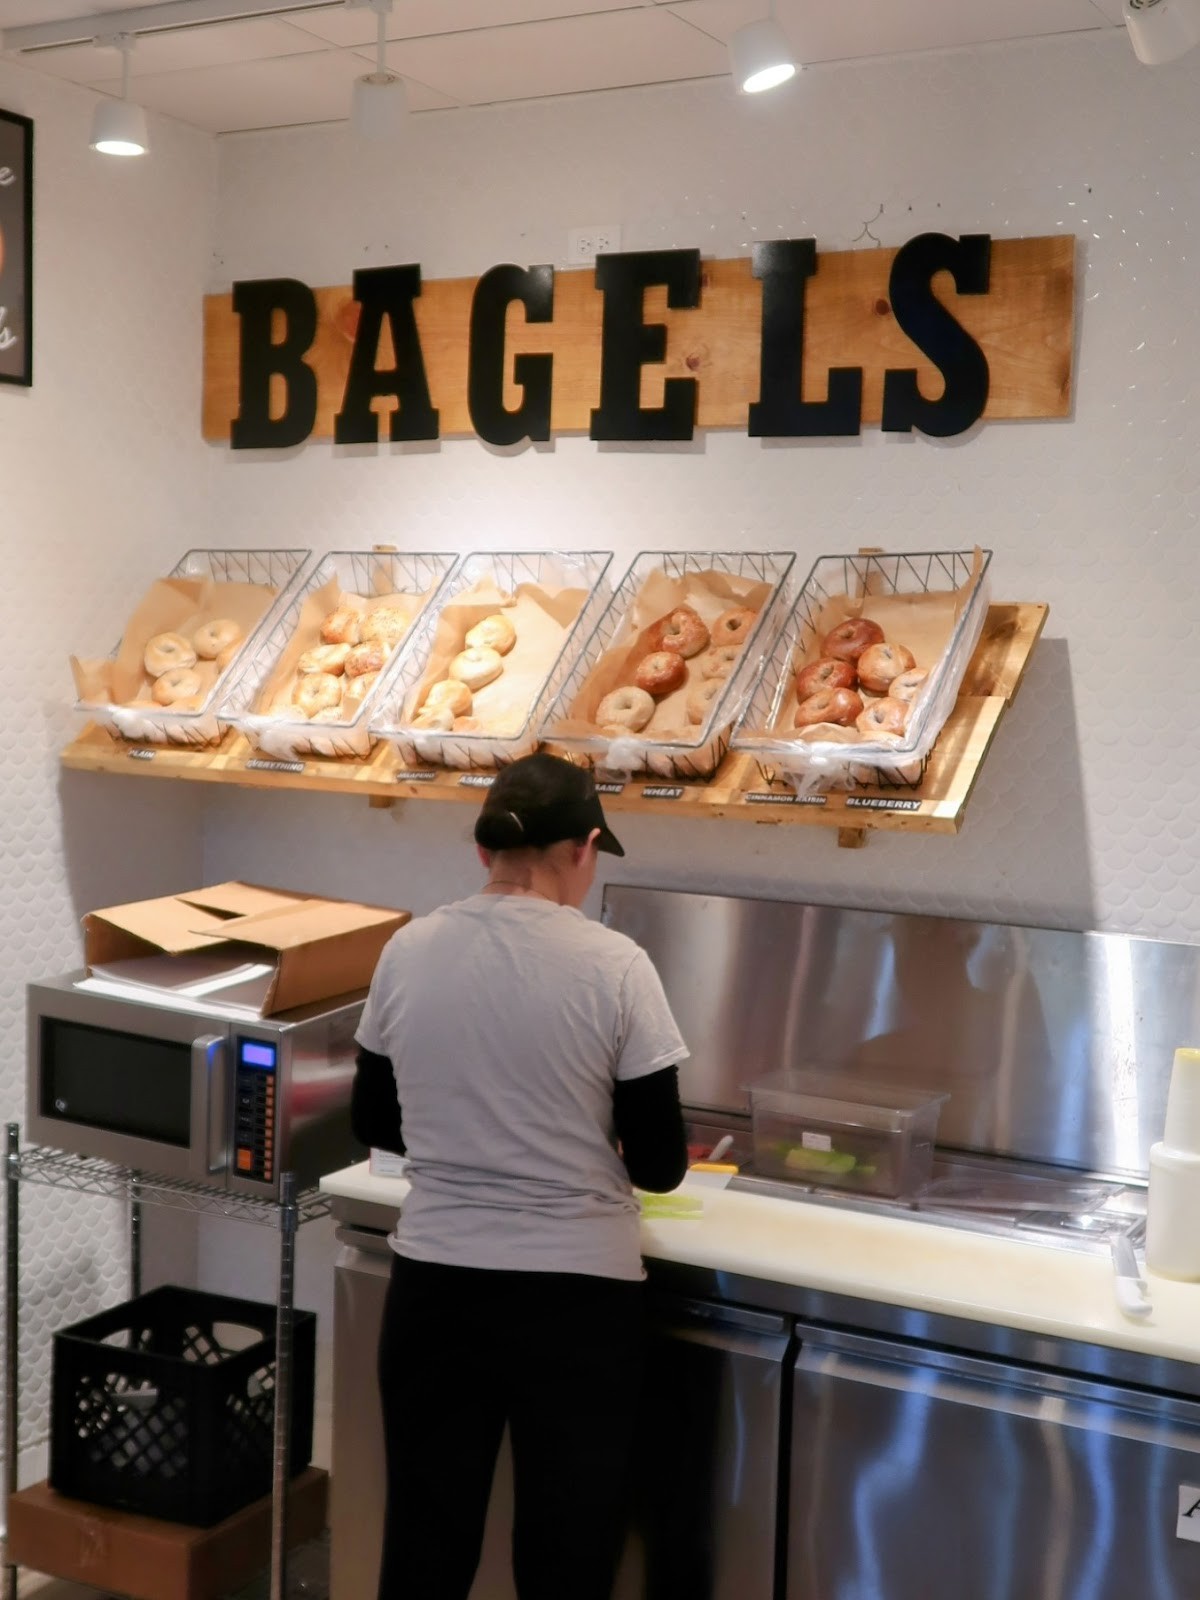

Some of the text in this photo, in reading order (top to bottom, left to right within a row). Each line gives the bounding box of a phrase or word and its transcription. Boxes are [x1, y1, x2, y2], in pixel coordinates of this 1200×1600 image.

[230, 232, 991, 450] BAGELS
[246, 759, 304, 772] EVERYTHING
[643, 788, 682, 796] WHEAT
[846, 798, 921, 810] BLUEBERRY
